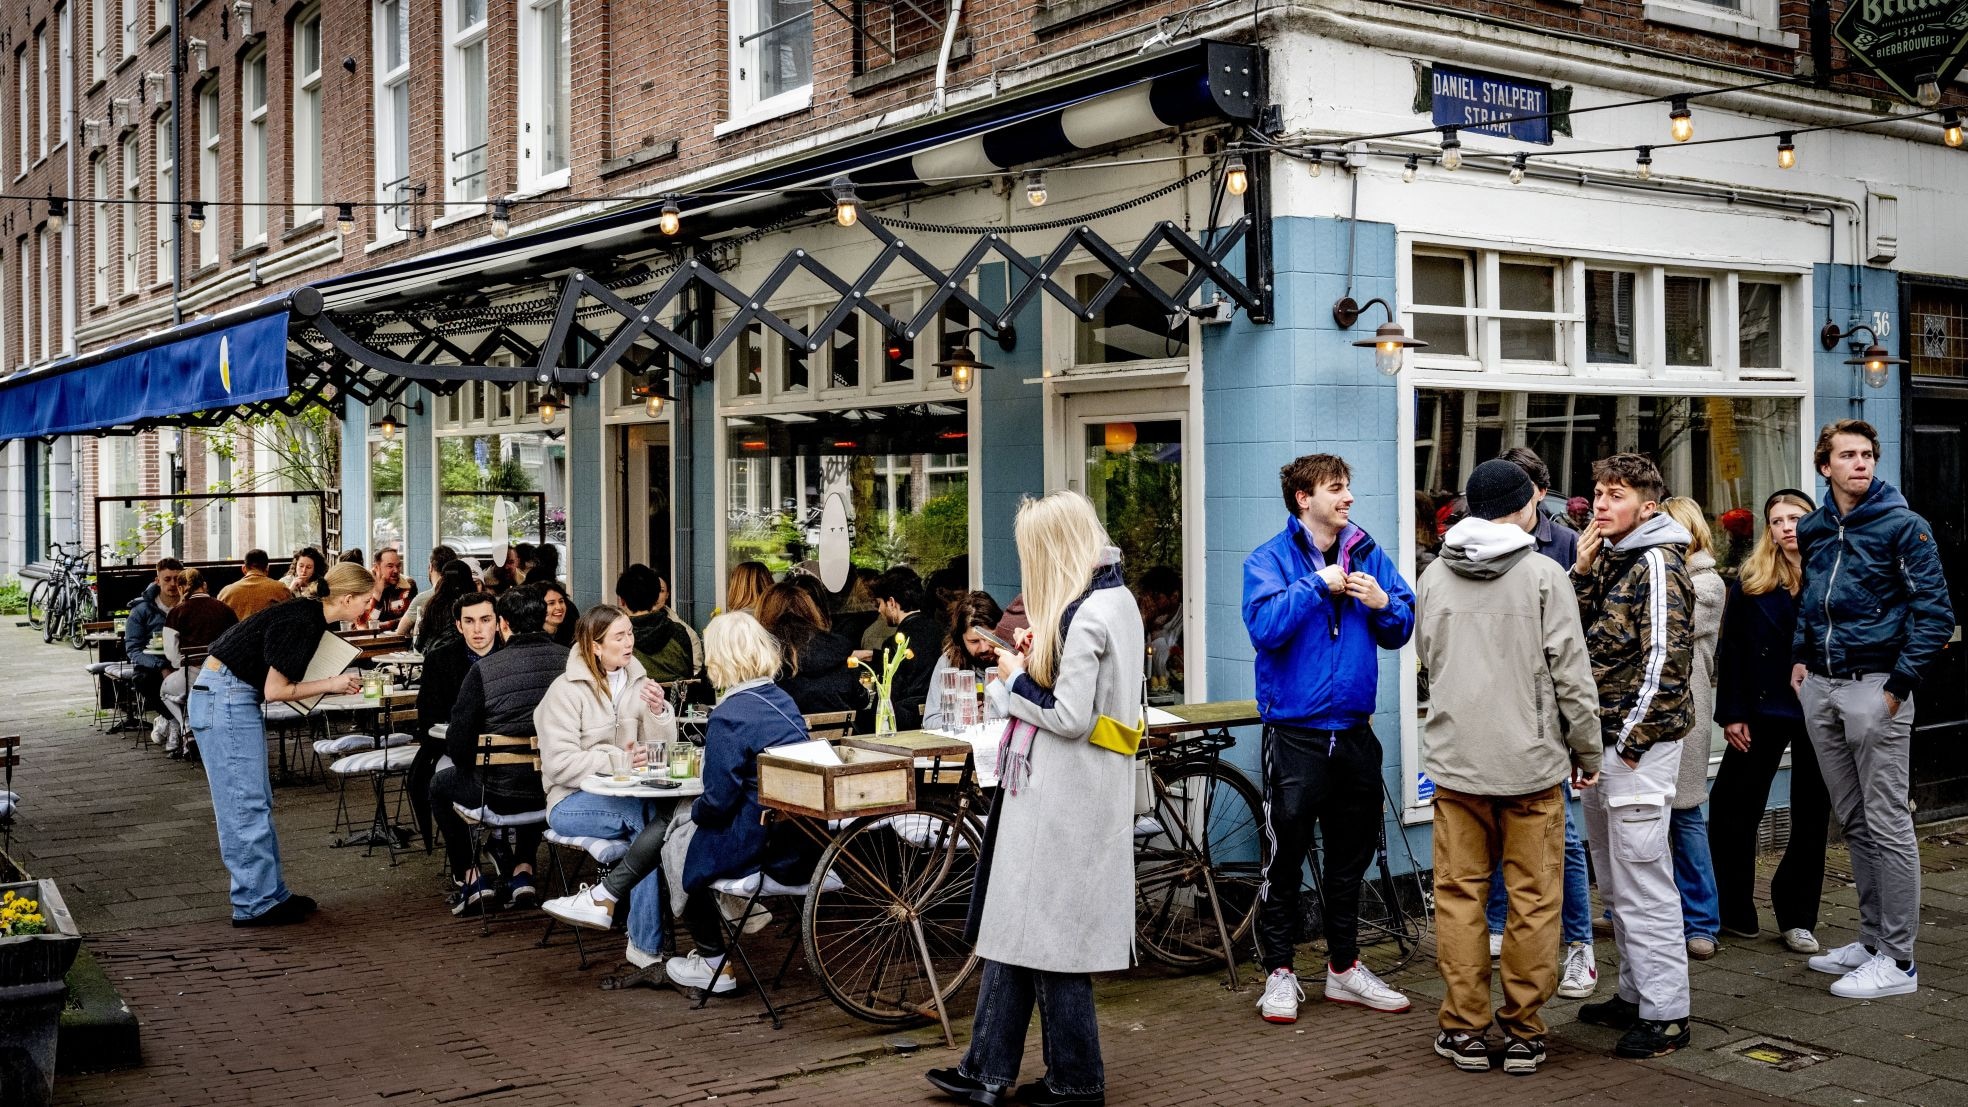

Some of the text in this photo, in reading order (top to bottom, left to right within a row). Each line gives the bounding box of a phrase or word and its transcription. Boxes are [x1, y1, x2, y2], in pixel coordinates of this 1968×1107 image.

[1897, 23, 1925, 38] 1340
[1876, 34, 1949, 58] BIERBROUWERIJ
[1433, 73, 1542, 112] DANIEL STALPERT
[1464, 105, 1513, 134] STRAAT
[1873, 311, 1890, 336] 36
